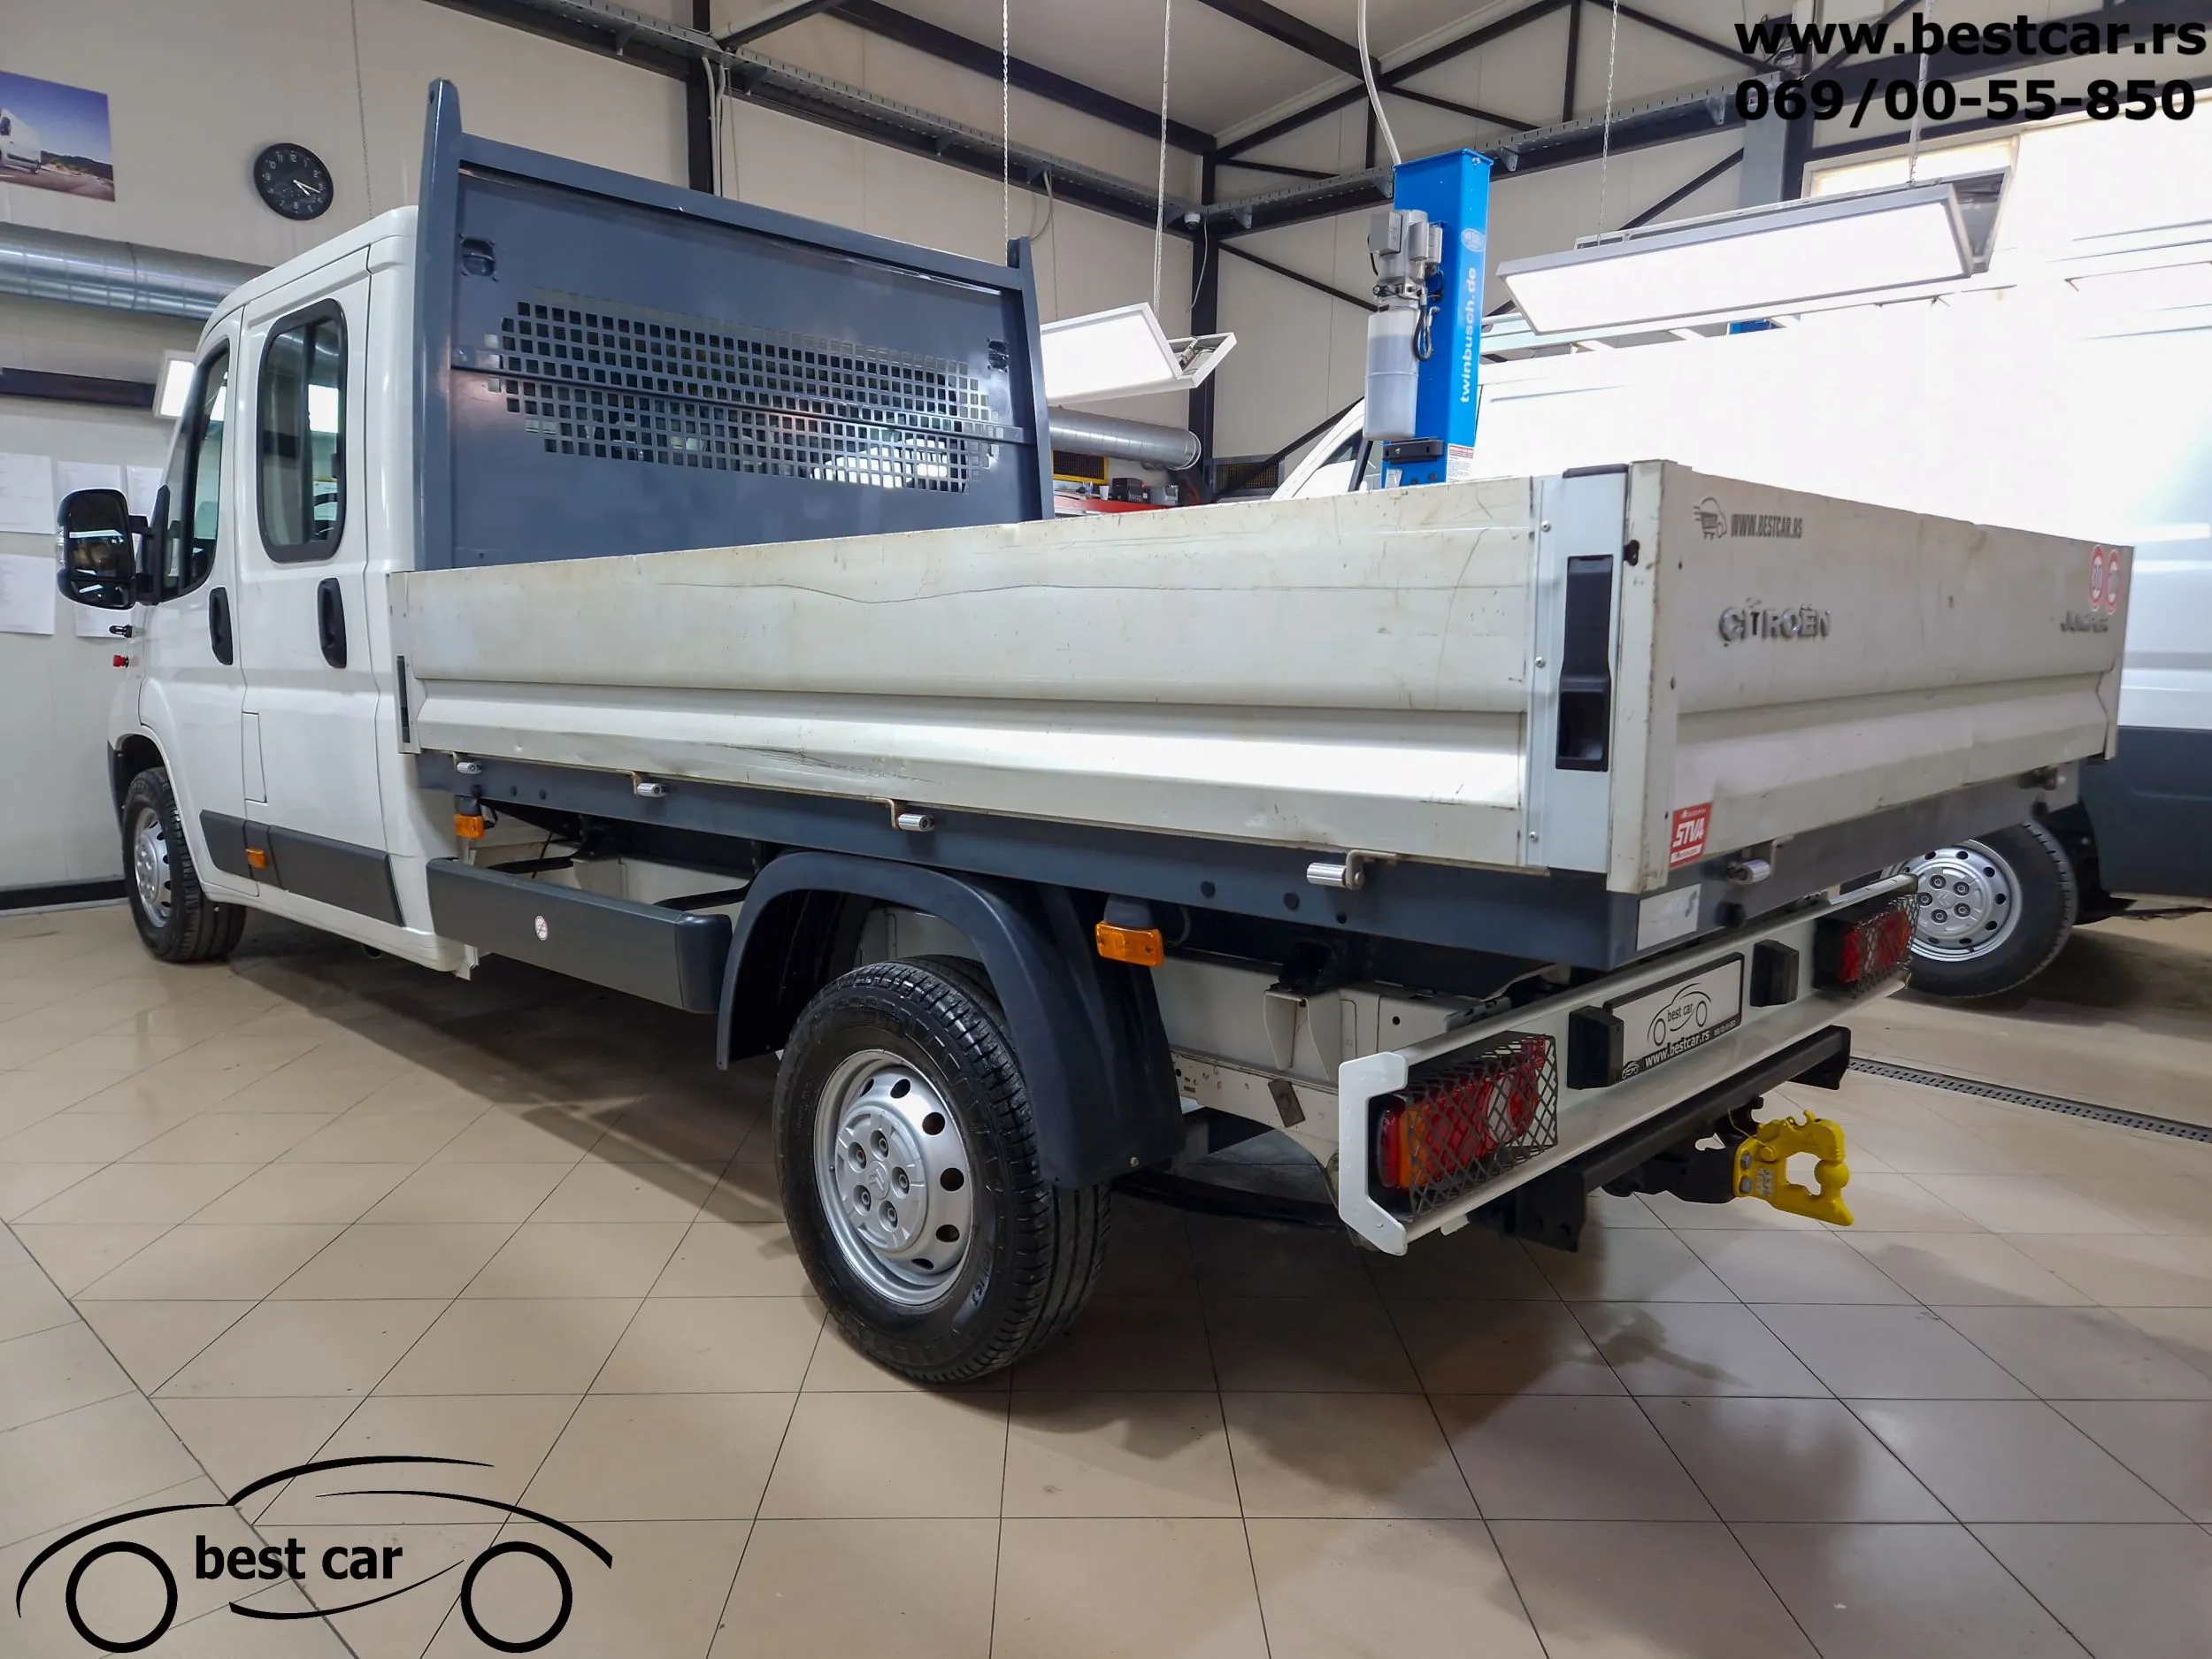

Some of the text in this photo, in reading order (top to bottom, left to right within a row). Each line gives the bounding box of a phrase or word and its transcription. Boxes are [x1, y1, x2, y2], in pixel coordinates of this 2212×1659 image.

[1460, 267, 1477, 403] twinbusch.de
[1731, 513, 1803, 539] WWW.BESTCAR.RS
[1718, 603, 1832, 642] CITROËN
[1667, 1002, 1694, 1023] best car
[1645, 1030, 1709, 1067] www.bestcar.rs
